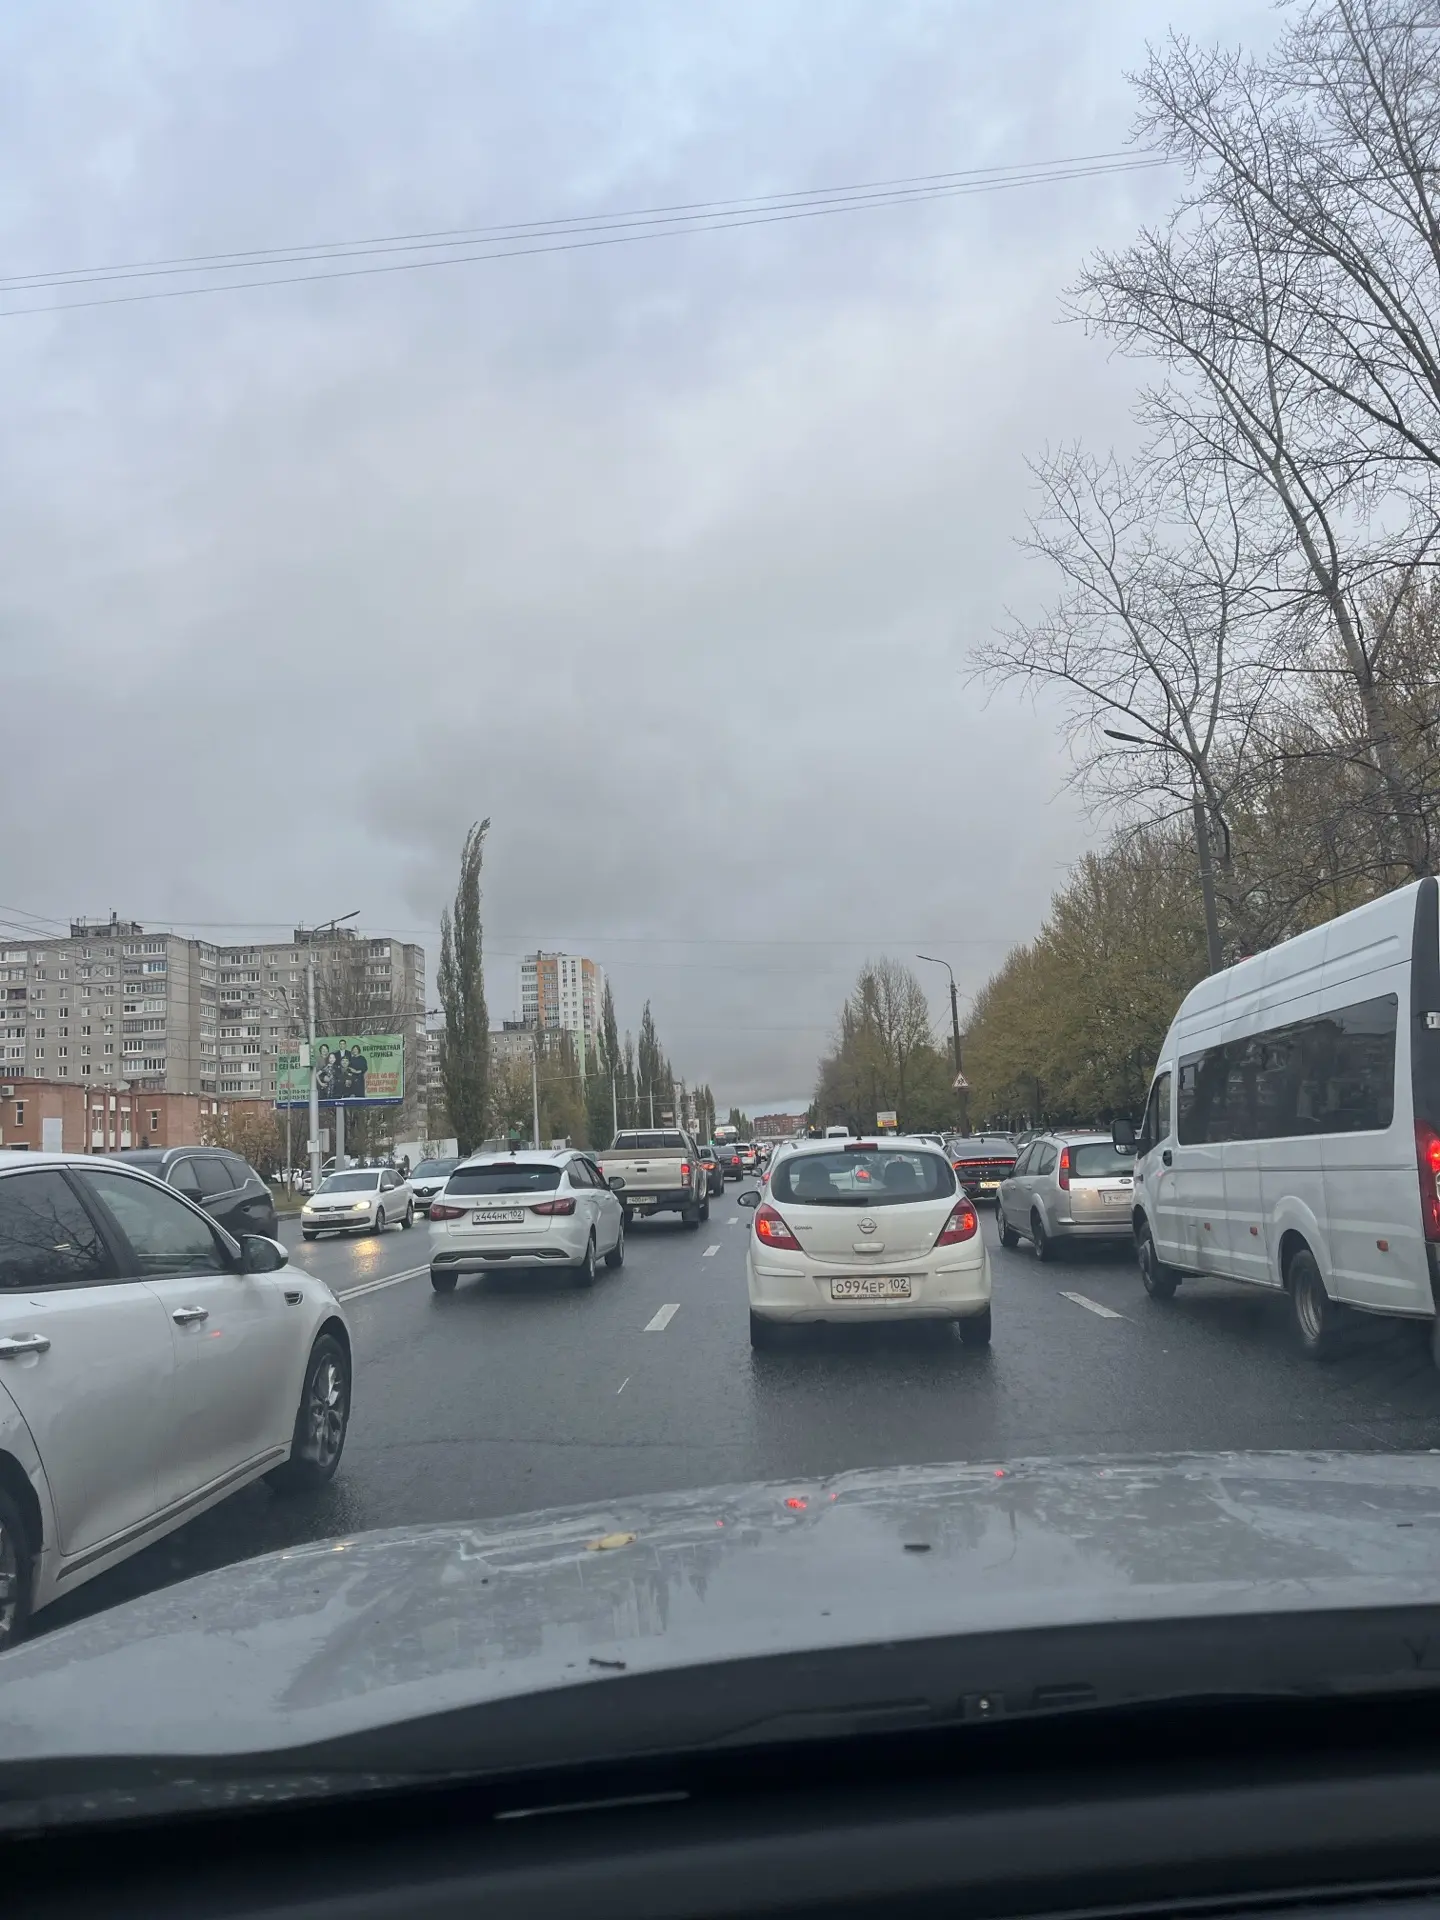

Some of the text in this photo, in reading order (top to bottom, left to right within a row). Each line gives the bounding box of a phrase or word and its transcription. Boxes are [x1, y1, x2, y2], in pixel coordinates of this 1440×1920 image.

[362, 1043, 401, 1052] КОНТРАКТНАЯ
[510, 1210, 522, 1218] 102
[889, 1278, 907, 1289] 102
